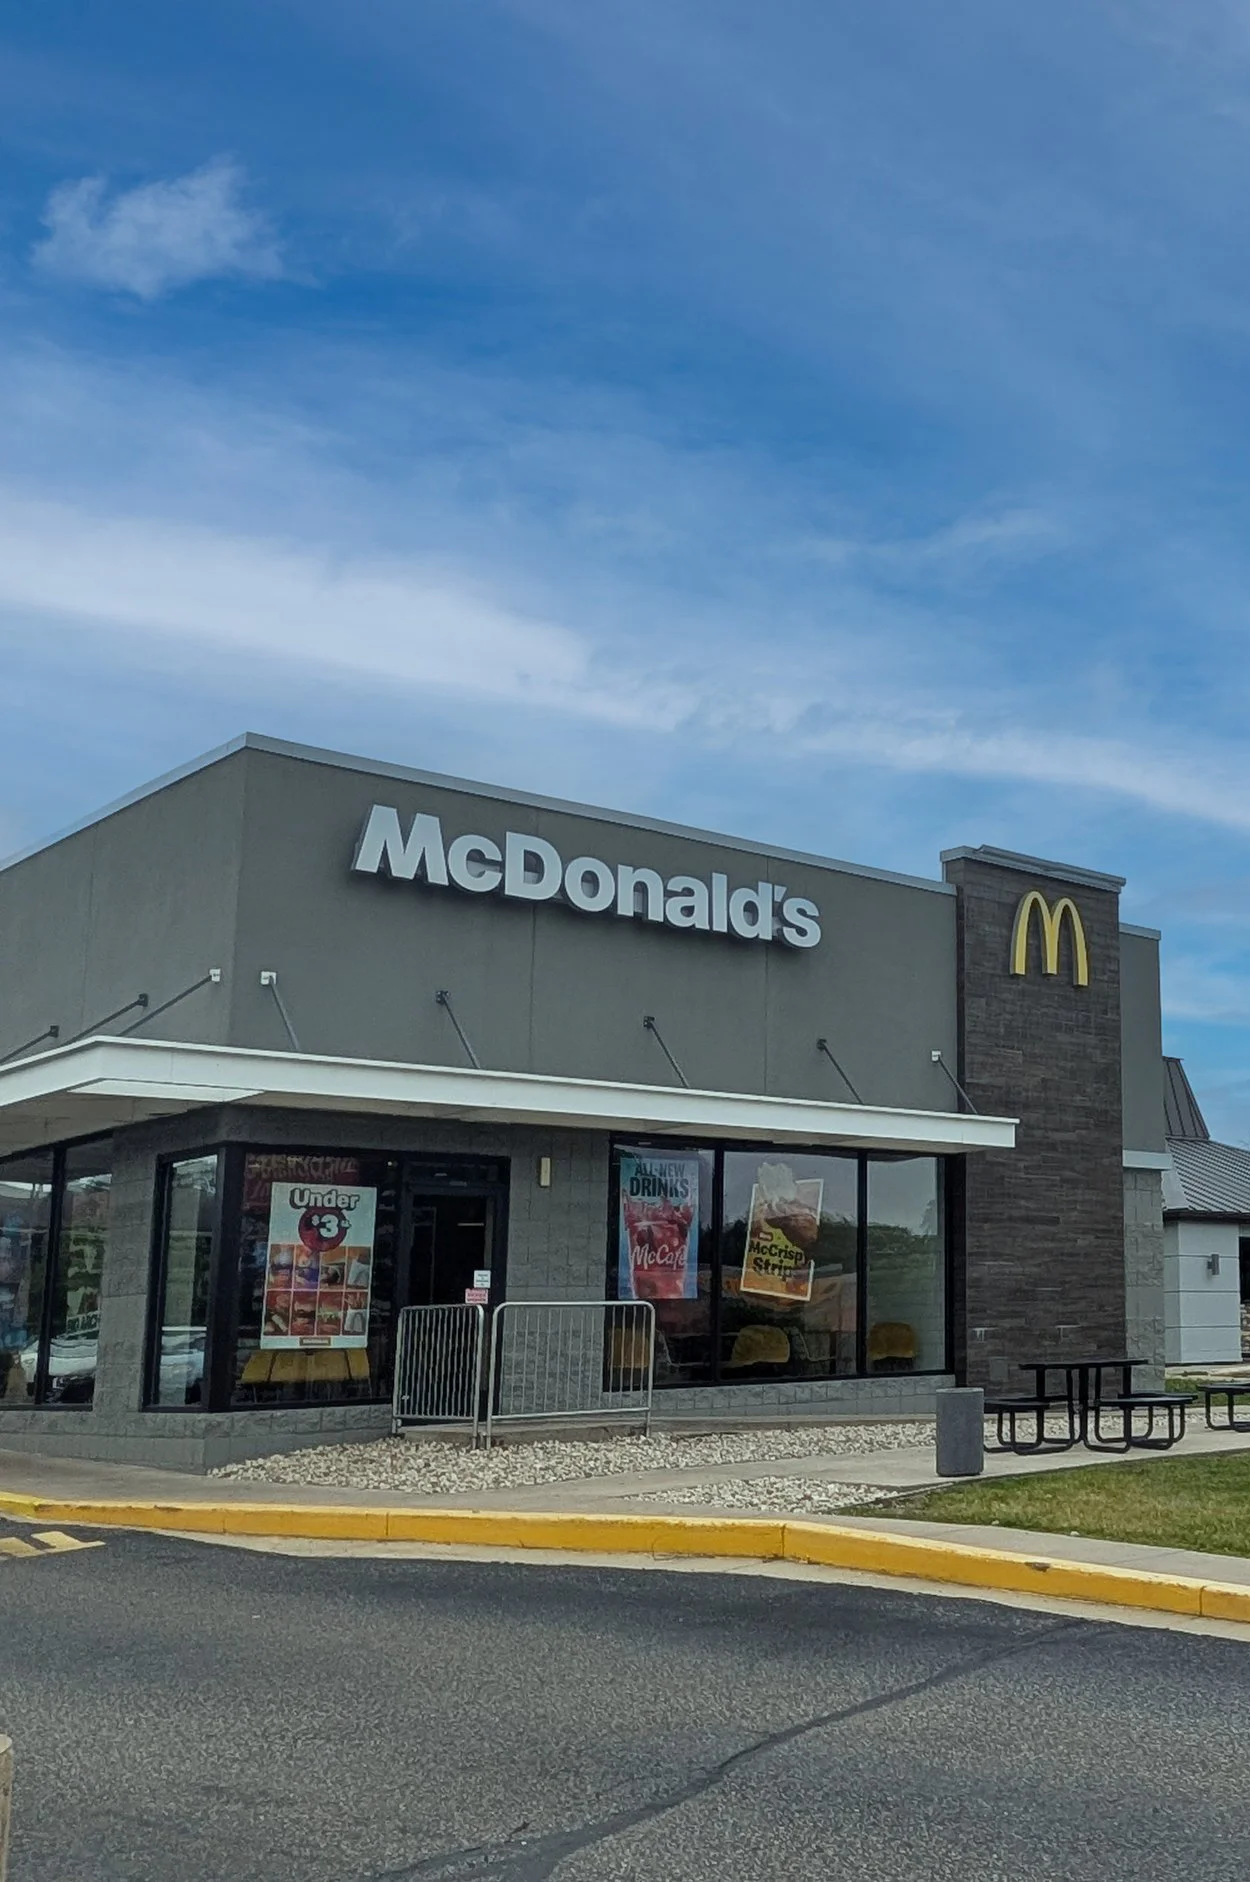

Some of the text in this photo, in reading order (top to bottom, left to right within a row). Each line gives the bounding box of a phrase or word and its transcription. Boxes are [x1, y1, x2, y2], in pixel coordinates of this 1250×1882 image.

[354, 803, 822, 948] McDonald's
[634, 1162, 686, 1178] ALL-NEW
[290, 1187, 360, 1210] Under
[629, 1176, 690, 1199] DRINKS
